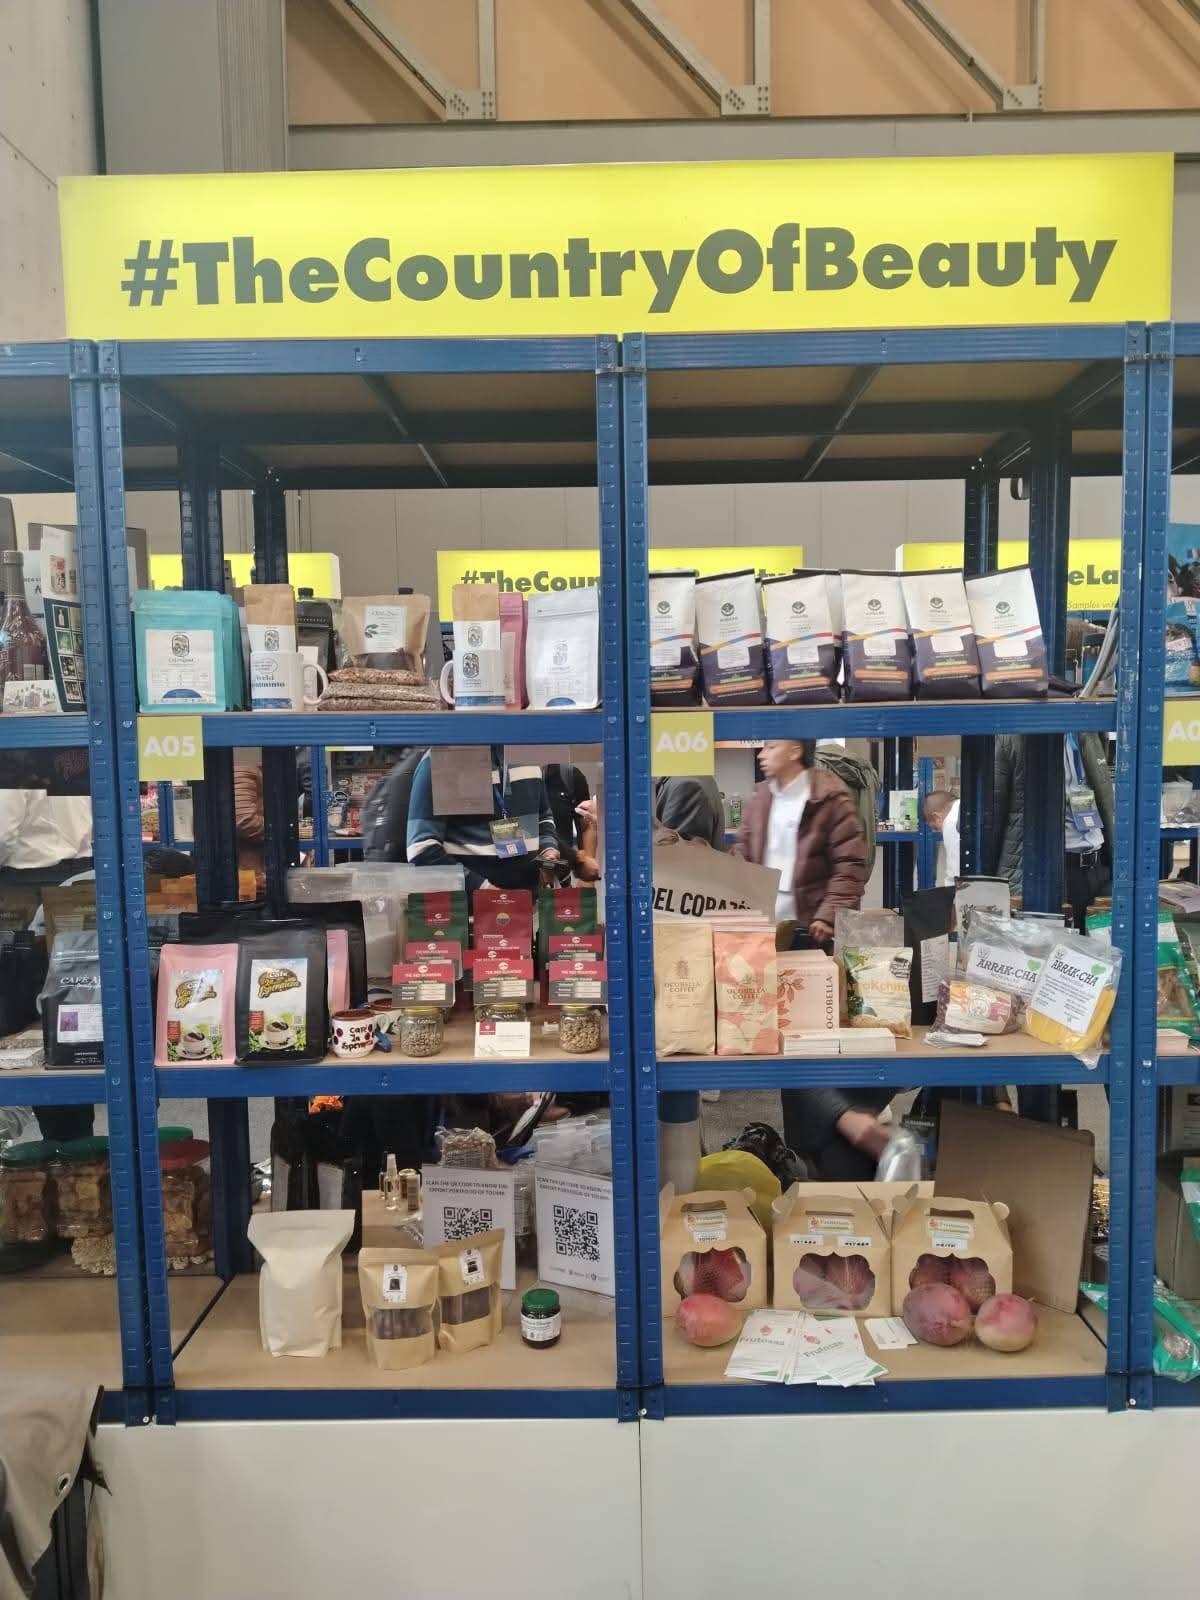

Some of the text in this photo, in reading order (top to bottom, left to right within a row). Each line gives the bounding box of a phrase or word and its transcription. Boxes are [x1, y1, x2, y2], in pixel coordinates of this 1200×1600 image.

[121, 224, 1117, 313] #TheCountryOfBeauty
[144, 735, 196, 758] A05
[656, 730, 709, 753] A06
[976, 958, 1038, 983] ARRAK-CHA
[1051, 959, 1099, 987] ARRAK-CHA
[825, 976, 834, 1030] OCOBELLA
